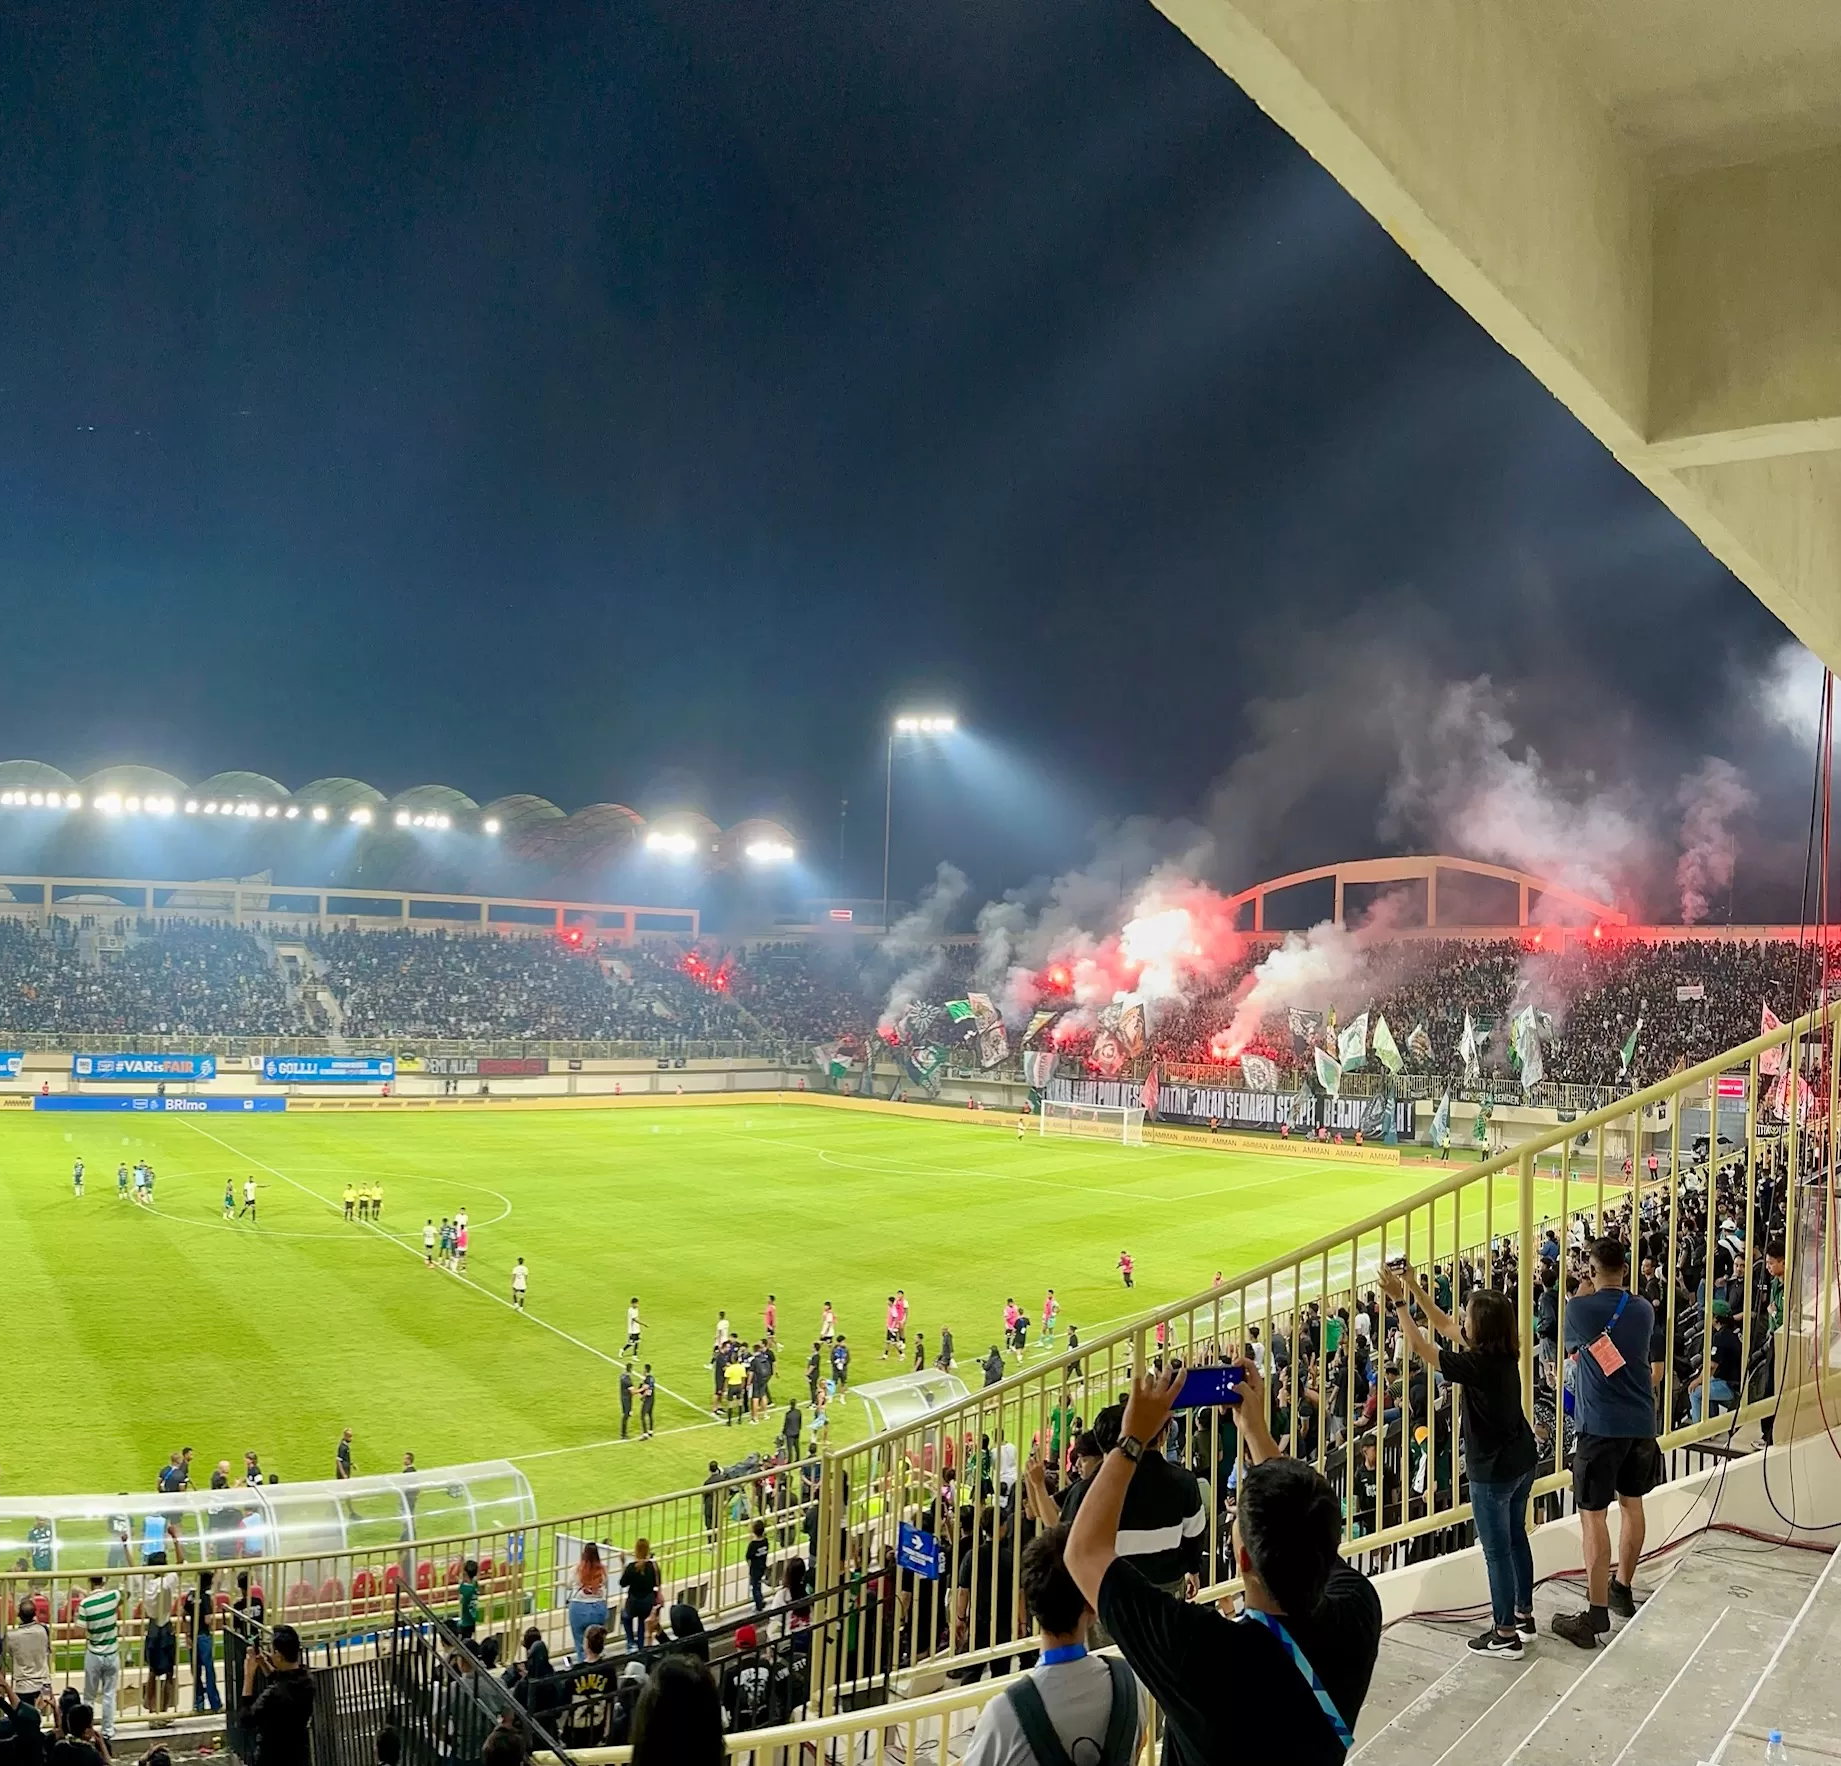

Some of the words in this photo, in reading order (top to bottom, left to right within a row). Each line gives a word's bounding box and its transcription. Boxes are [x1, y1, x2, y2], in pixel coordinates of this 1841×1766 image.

[1193, 1088, 1225, 1119] JALAN
[1226, 1091, 1275, 1123] SEMAKIN
[1154, 1132, 1178, 1141] AMMAN
[1183, 1135, 1208, 1144] AMMAN
[1211, 1137, 1237, 1147] AMMAN
[1242, 1140, 1268, 1150] AMMAN
[1270, 1143, 1297, 1153] AMMAN
[1302, 1145, 1330, 1156] AMMAN
[1335, 1148, 1363, 1159] AMMAN
[1369, 1151, 1399, 1162] AMMAN
[574, 1673, 609, 1694] JAMES
